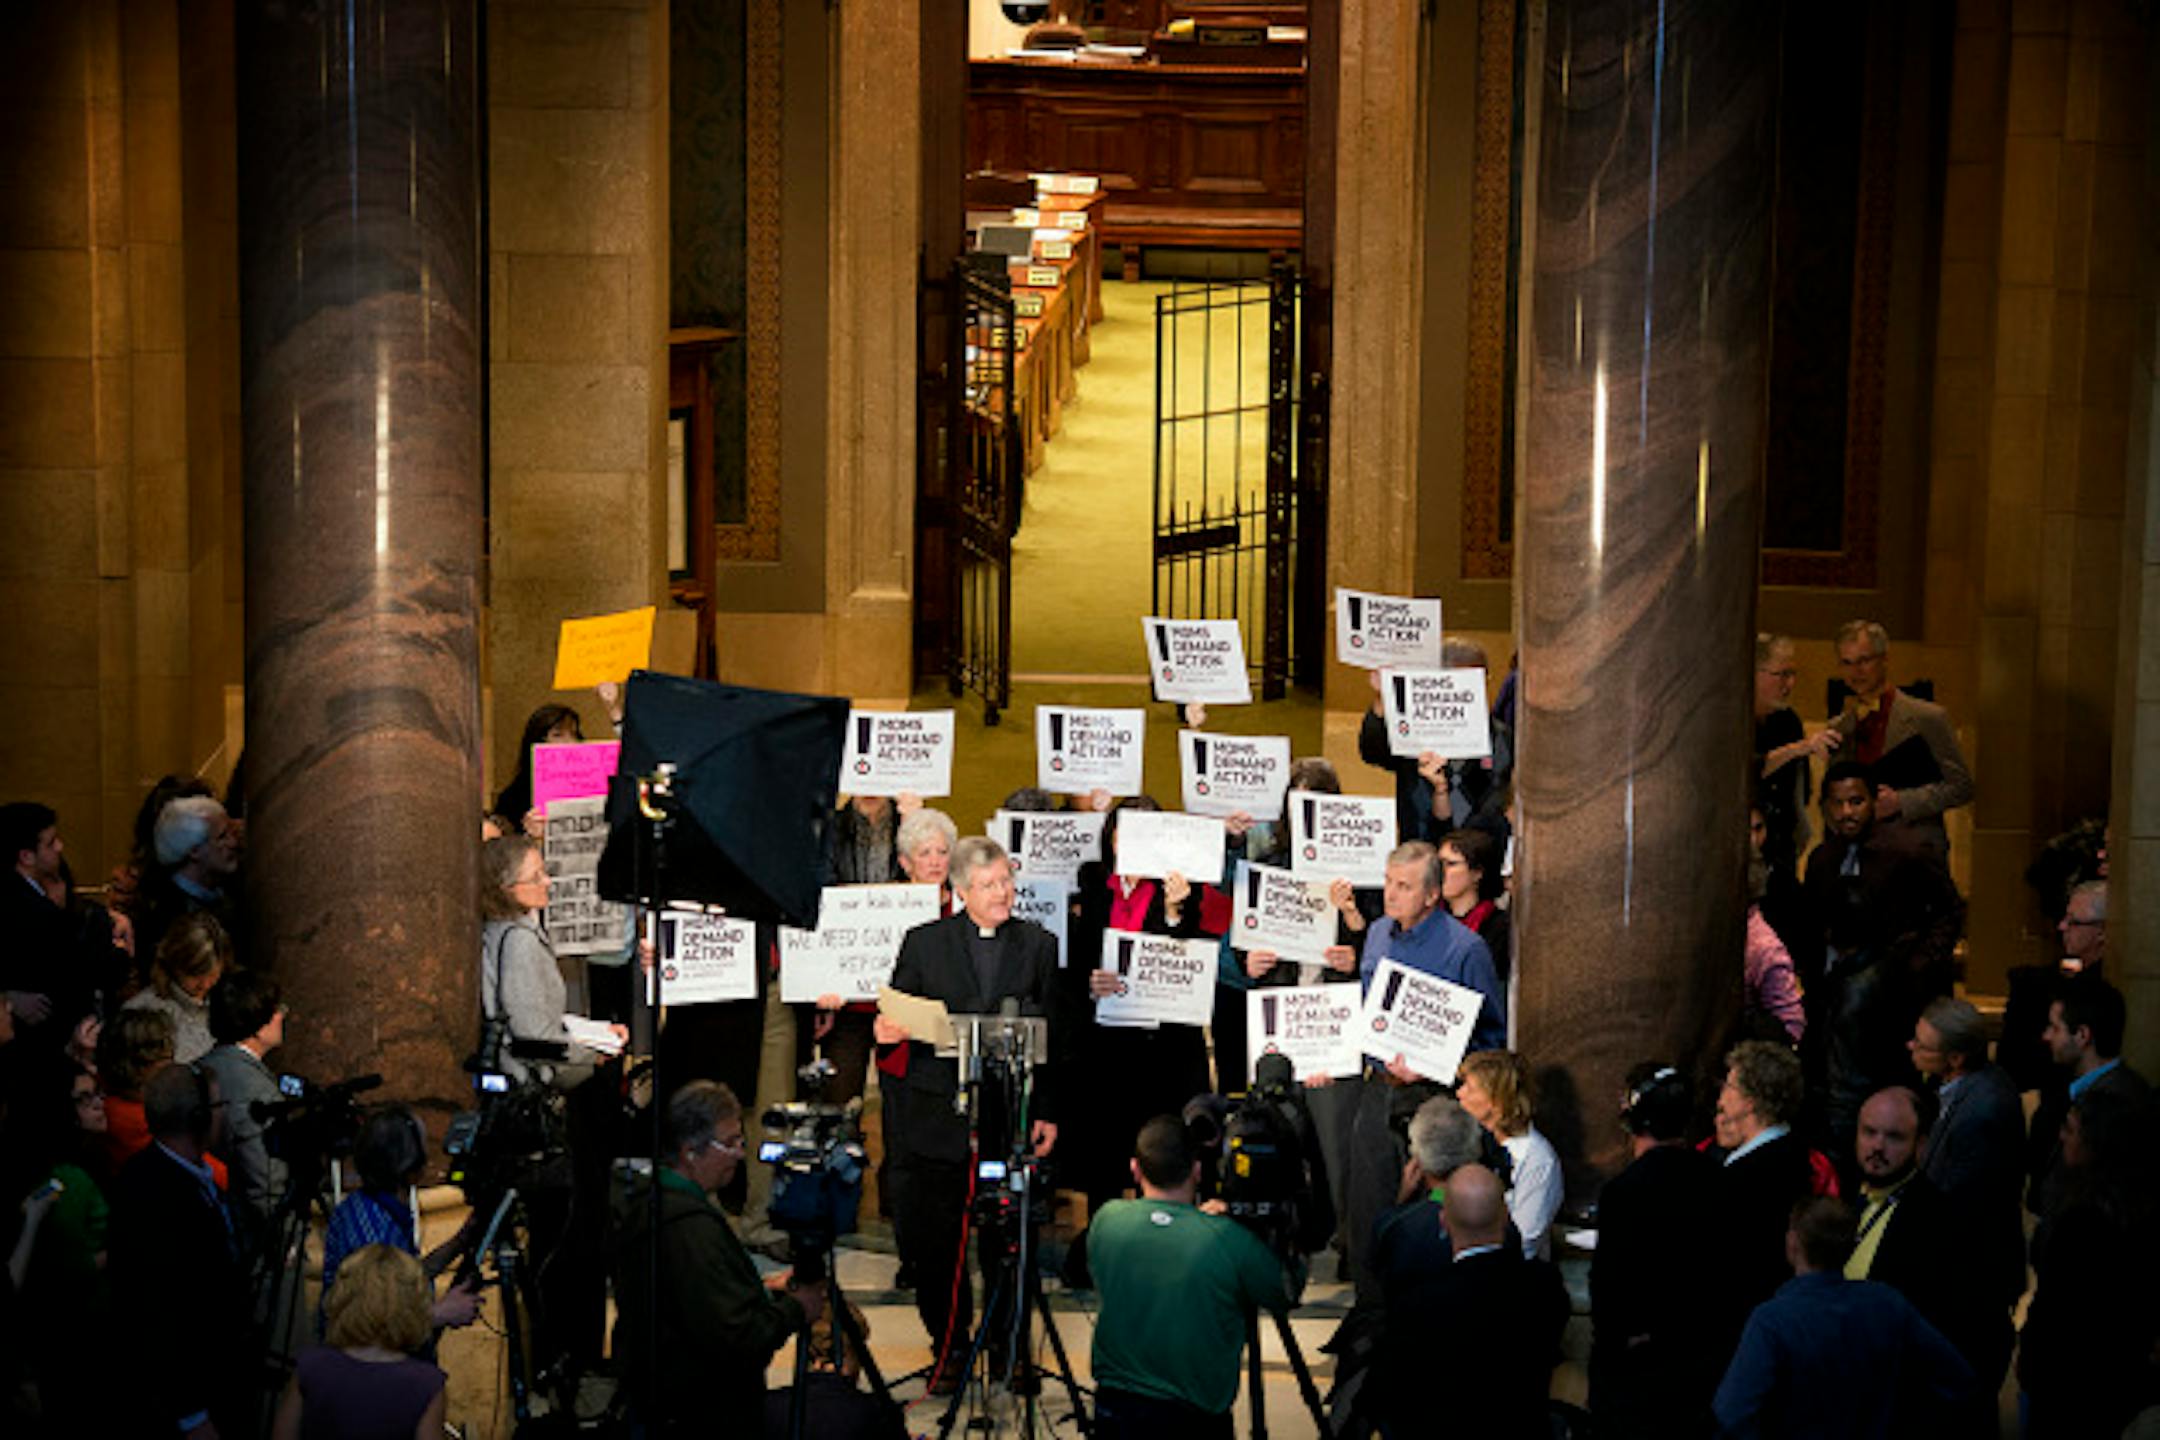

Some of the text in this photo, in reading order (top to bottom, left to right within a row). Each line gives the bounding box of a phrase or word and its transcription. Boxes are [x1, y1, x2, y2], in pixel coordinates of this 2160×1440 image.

[1368, 600, 1411, 615] MOMS
[1368, 613, 1430, 632] DEMAND
[1172, 626, 1211, 639] MOMS
[1368, 627, 1420, 642] ACTION
[1173, 641, 1231, 653] DEMAND
[1176, 655, 1223, 669] ACTION
[1412, 675, 1454, 690] MOMS
[1412, 691, 1475, 704] DEMAND
[1413, 705, 1465, 720] ACTION
[879, 719, 922, 731] MOMS
[1070, 714, 1115, 729] MOMS
[878, 733, 942, 745] DEMAND
[1070, 730, 1132, 744] DEMAND
[878, 747, 929, 761] ACTION
[1070, 742, 1122, 758] ACTION
[1214, 740, 1258, 756] MOMS
[1214, 755, 1276, 772] DEMAND
[1214, 771, 1266, 785] ACTION
[1321, 801, 1364, 816] MOMS
[1031, 819, 1077, 834] MOMS
[1321, 815, 1383, 834] DEMAND
[1031, 832, 1094, 847] DEMAND
[1321, 832, 1373, 848] ACTION
[1029, 848, 1081, 861] ACTION
[1267, 873, 1309, 894] MOMS
[1265, 888, 1327, 912] DEMAND
[1264, 905, 1314, 925] ACTION
[683, 928, 744, 947] DEMAND
[819, 928, 857, 949] NEED
[863, 927, 891, 947] GUN
[683, 946, 734, 961] ACTION
[1141, 940, 1187, 957] MOMS
[839, 954, 892, 974] REFOR
[1138, 956, 1204, 974] DEMAND
[1138, 970, 1193, 985] ACTION
[1409, 978, 1451, 1004] MOMS
[1285, 992, 1331, 1007] MOMS
[1285, 1007, 1351, 1023] DEMAND
[1402, 992, 1464, 1026] DEMAND
[1398, 1008, 1448, 1036] ACTION
[1285, 1024, 1341, 1039] ACTION
